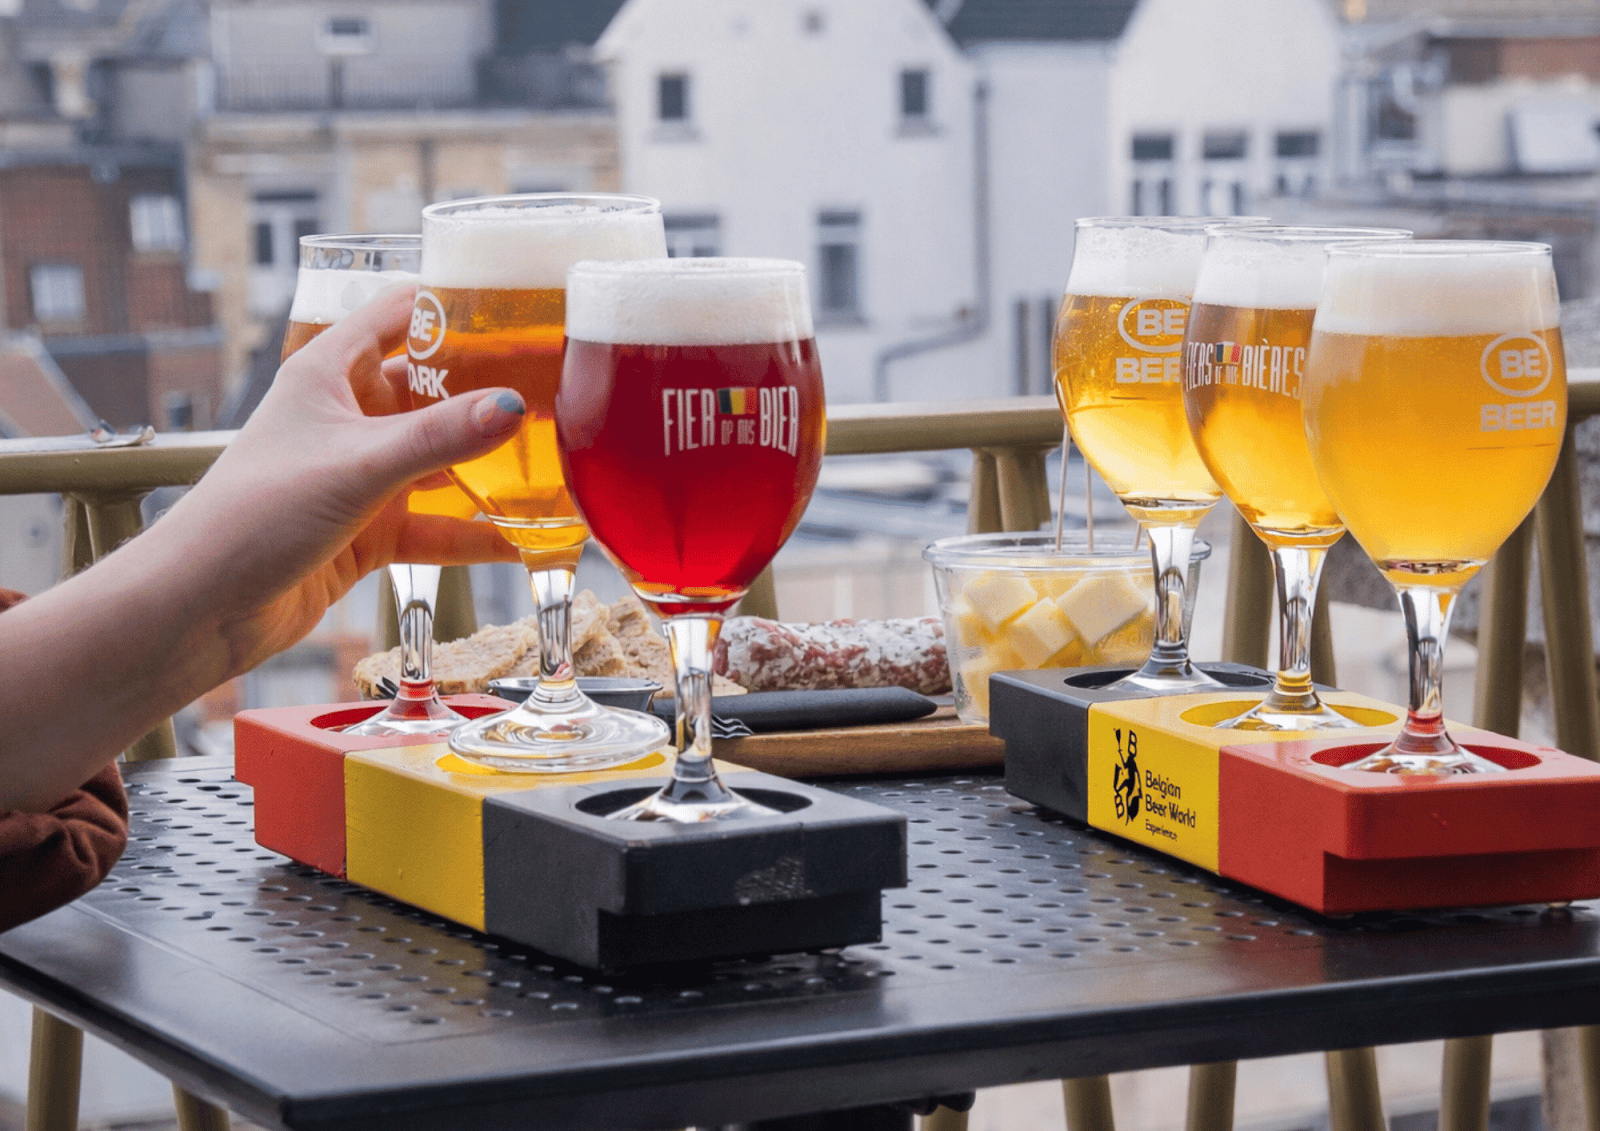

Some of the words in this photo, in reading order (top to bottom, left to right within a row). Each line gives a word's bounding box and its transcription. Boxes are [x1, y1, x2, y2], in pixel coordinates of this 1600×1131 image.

[410, 307, 436, 342] BE
[1137, 309, 1185, 336] BE
[408, 362, 450, 400] ARK
[1242, 338, 1305, 400] BIÈRES
[1499, 348, 1542, 379] BE
[662, 387, 715, 457] FIER
[759, 385, 799, 457] BIER
[1480, 400, 1556, 433] BEER
[1145, 769, 1181, 800] Belgian
[1145, 793, 1168, 818] Beer
[1168, 801, 1196, 828] World
